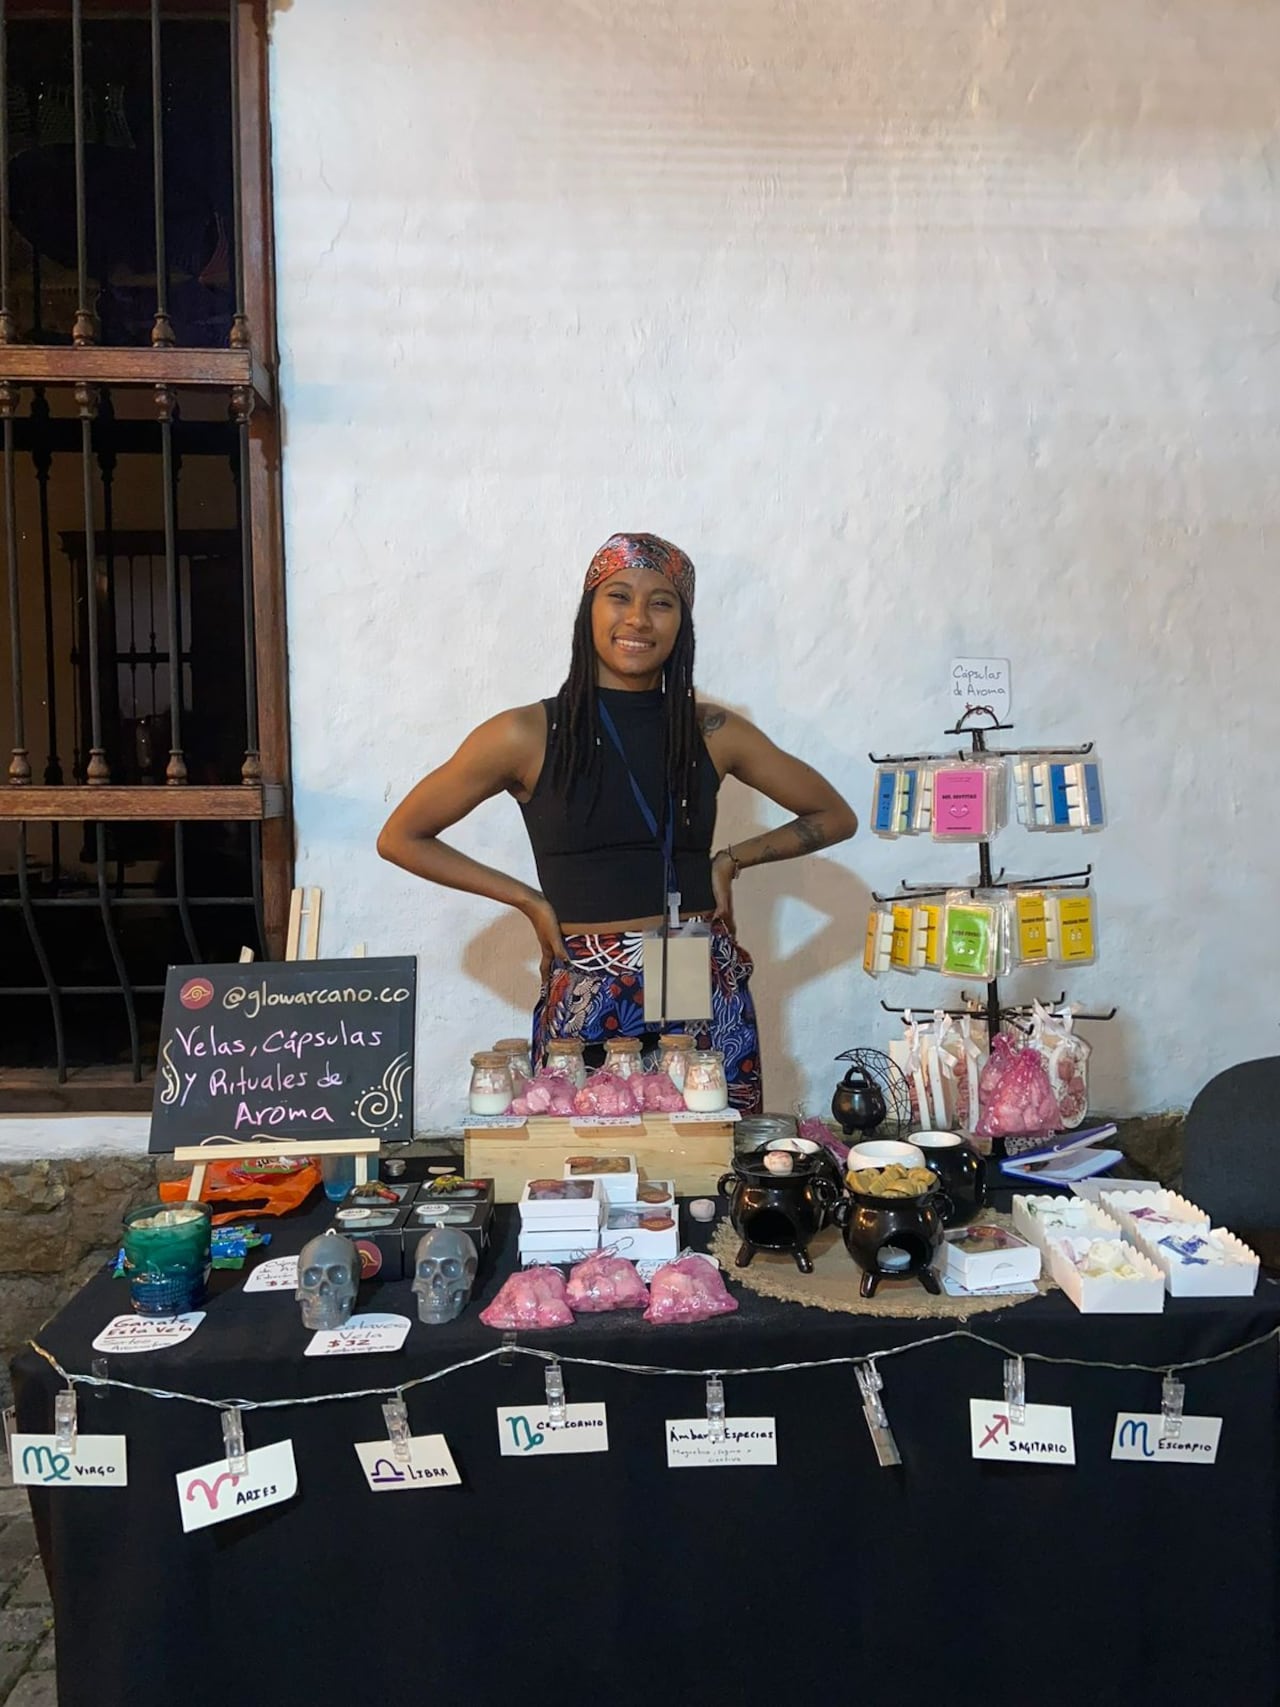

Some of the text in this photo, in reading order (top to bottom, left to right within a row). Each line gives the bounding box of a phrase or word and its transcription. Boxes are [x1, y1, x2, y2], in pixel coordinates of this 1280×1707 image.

[953, 681, 1007, 697] de Aroma
[222, 981, 410, 1018] @glowarcano.co
[176, 1020, 384, 1059] Velas, Cápsulas
[209, 1062, 308, 1097] Rituales
[316, 1061, 343, 1088] de
[234, 1101, 335, 1130] Aroma
[155, 1324, 193, 1333] Vela
[339, 1331, 383, 1340] Vela
[724, 1427, 774, 1443] Especias
[1009, 1440, 1067, 1454] SAGITARIO
[74, 1465, 115, 1477] VIRGO
[407, 1464, 448, 1480] LIBRA
[236, 1484, 277, 1505] ARIES
